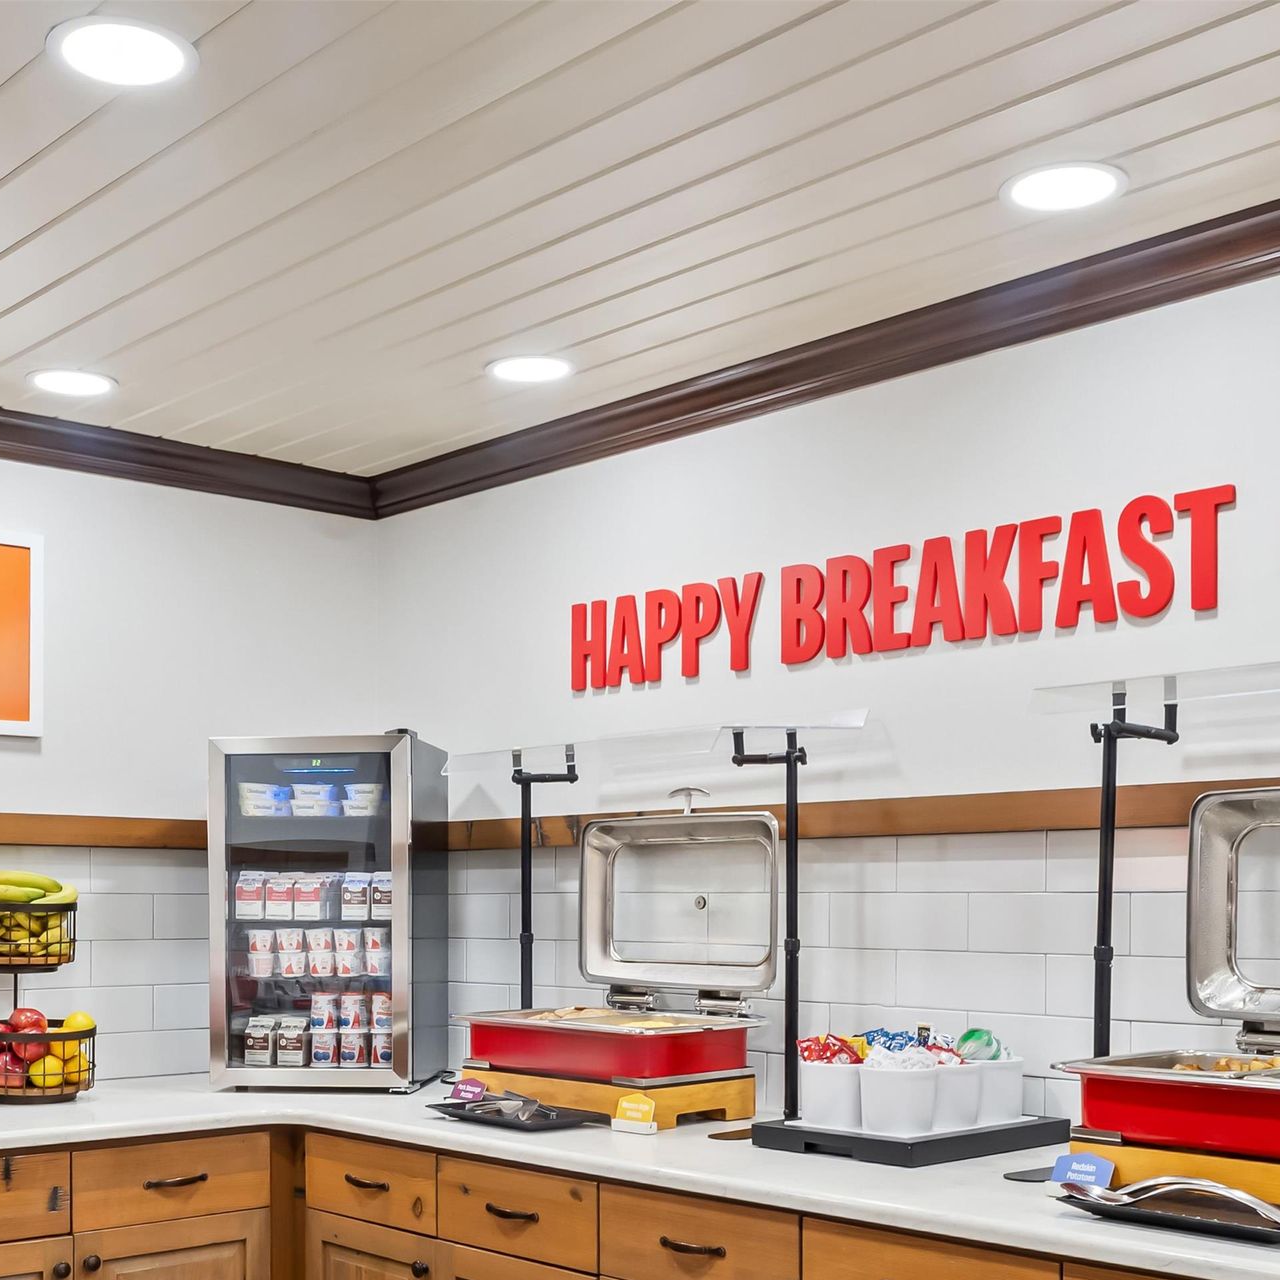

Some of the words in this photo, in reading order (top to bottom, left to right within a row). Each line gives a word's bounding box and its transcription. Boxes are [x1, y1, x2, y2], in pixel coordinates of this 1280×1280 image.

[571, 571, 764, 692] HAPPY
[780, 484, 1237, 665] BREAKFAST
[1071, 1161, 1097, 1173] Redskin
[1066, 1171, 1096, 1182] Potatoes
